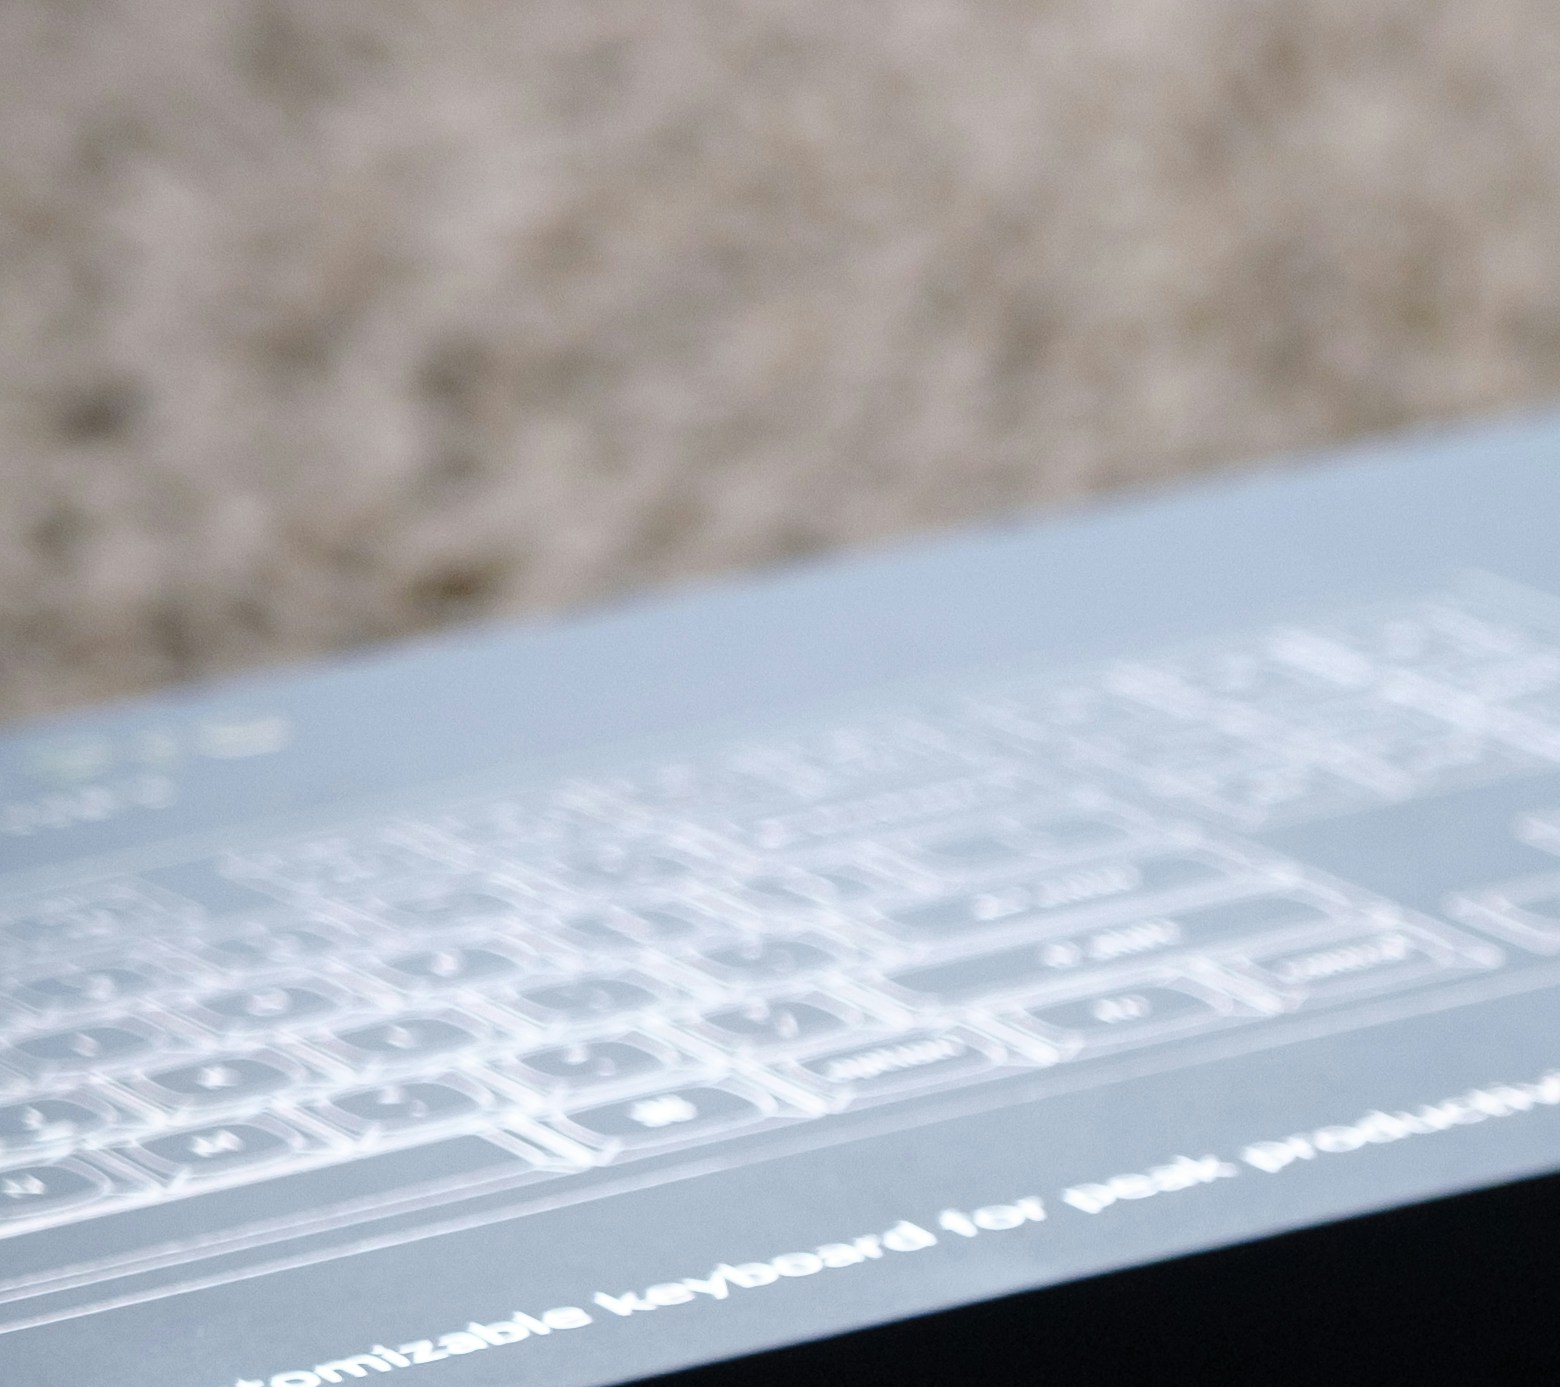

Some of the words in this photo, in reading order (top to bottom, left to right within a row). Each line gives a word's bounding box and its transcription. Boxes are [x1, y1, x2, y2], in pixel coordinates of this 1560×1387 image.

[594, 1221, 938, 1318] keyboard
[939, 1196, 1046, 1238] for
[1062, 1155, 1240, 1214] peak
